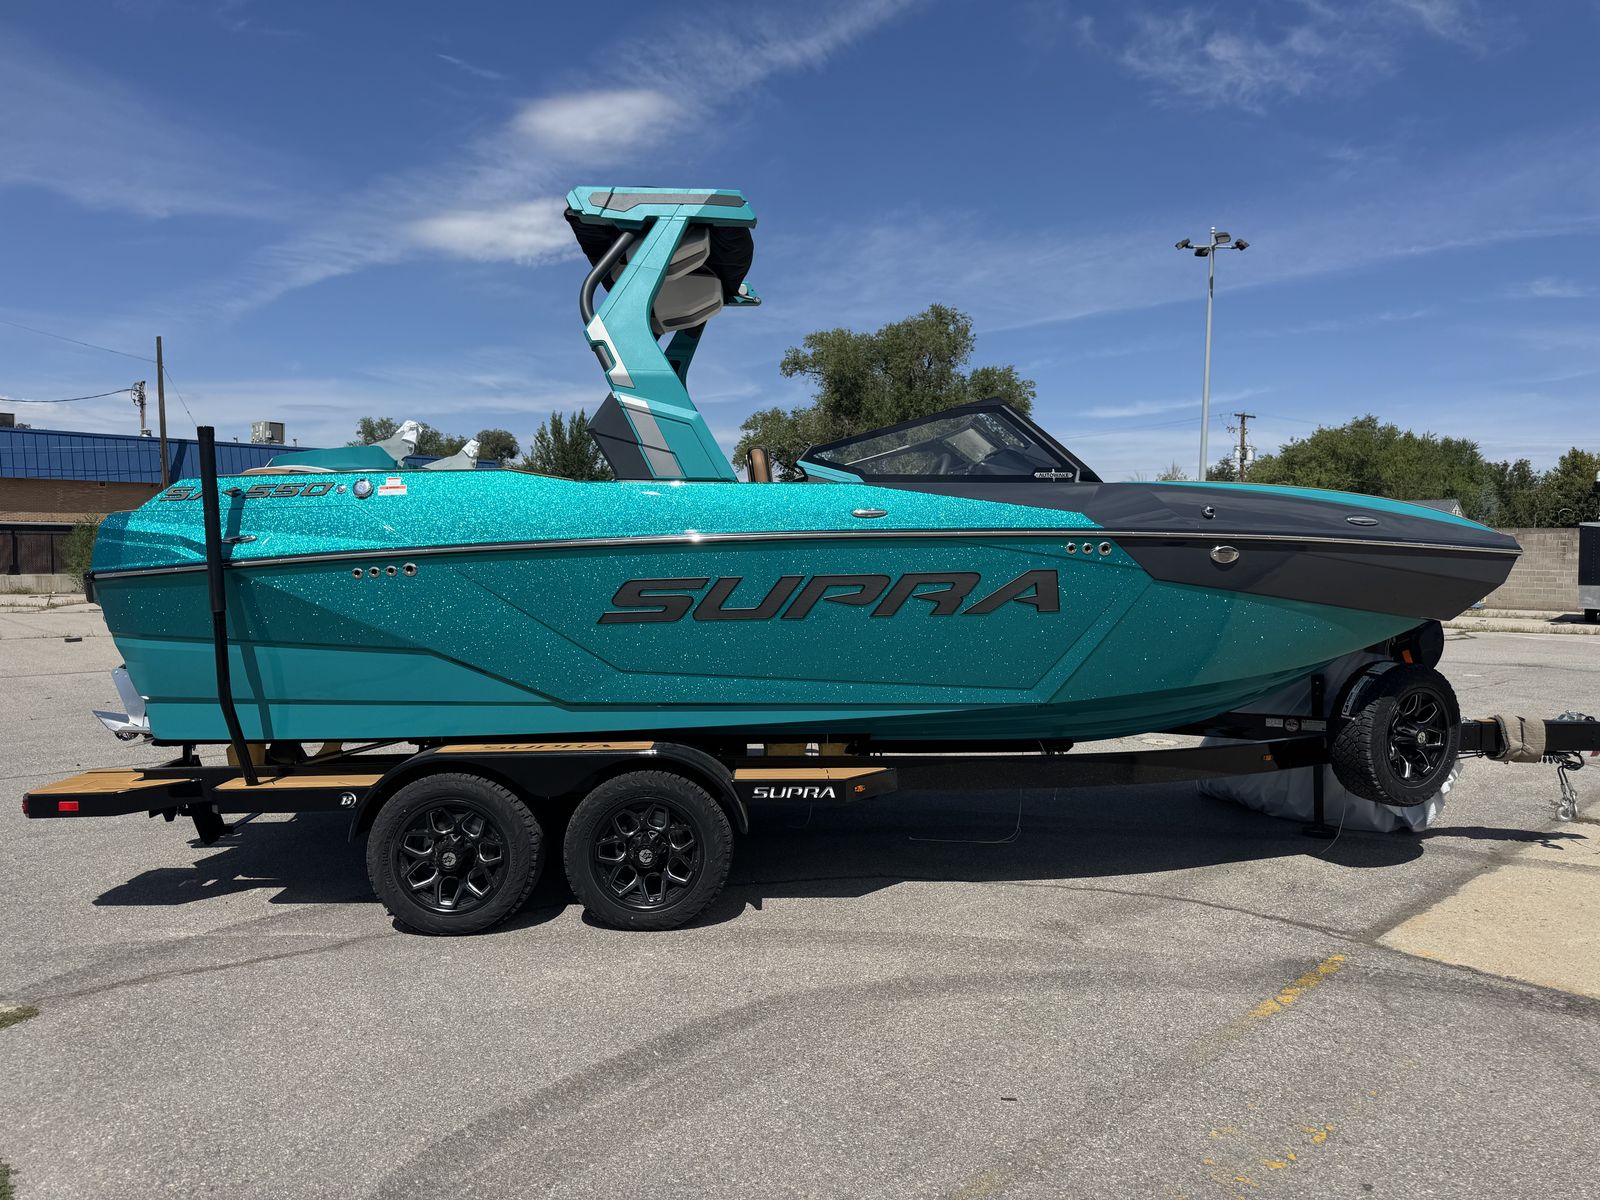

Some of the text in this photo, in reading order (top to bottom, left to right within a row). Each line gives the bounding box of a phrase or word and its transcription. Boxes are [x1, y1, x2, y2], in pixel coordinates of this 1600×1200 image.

[244, 482, 336, 499] 550
[597, 569, 1061, 624] SUPRA
[752, 786, 836, 799] SUPRA
